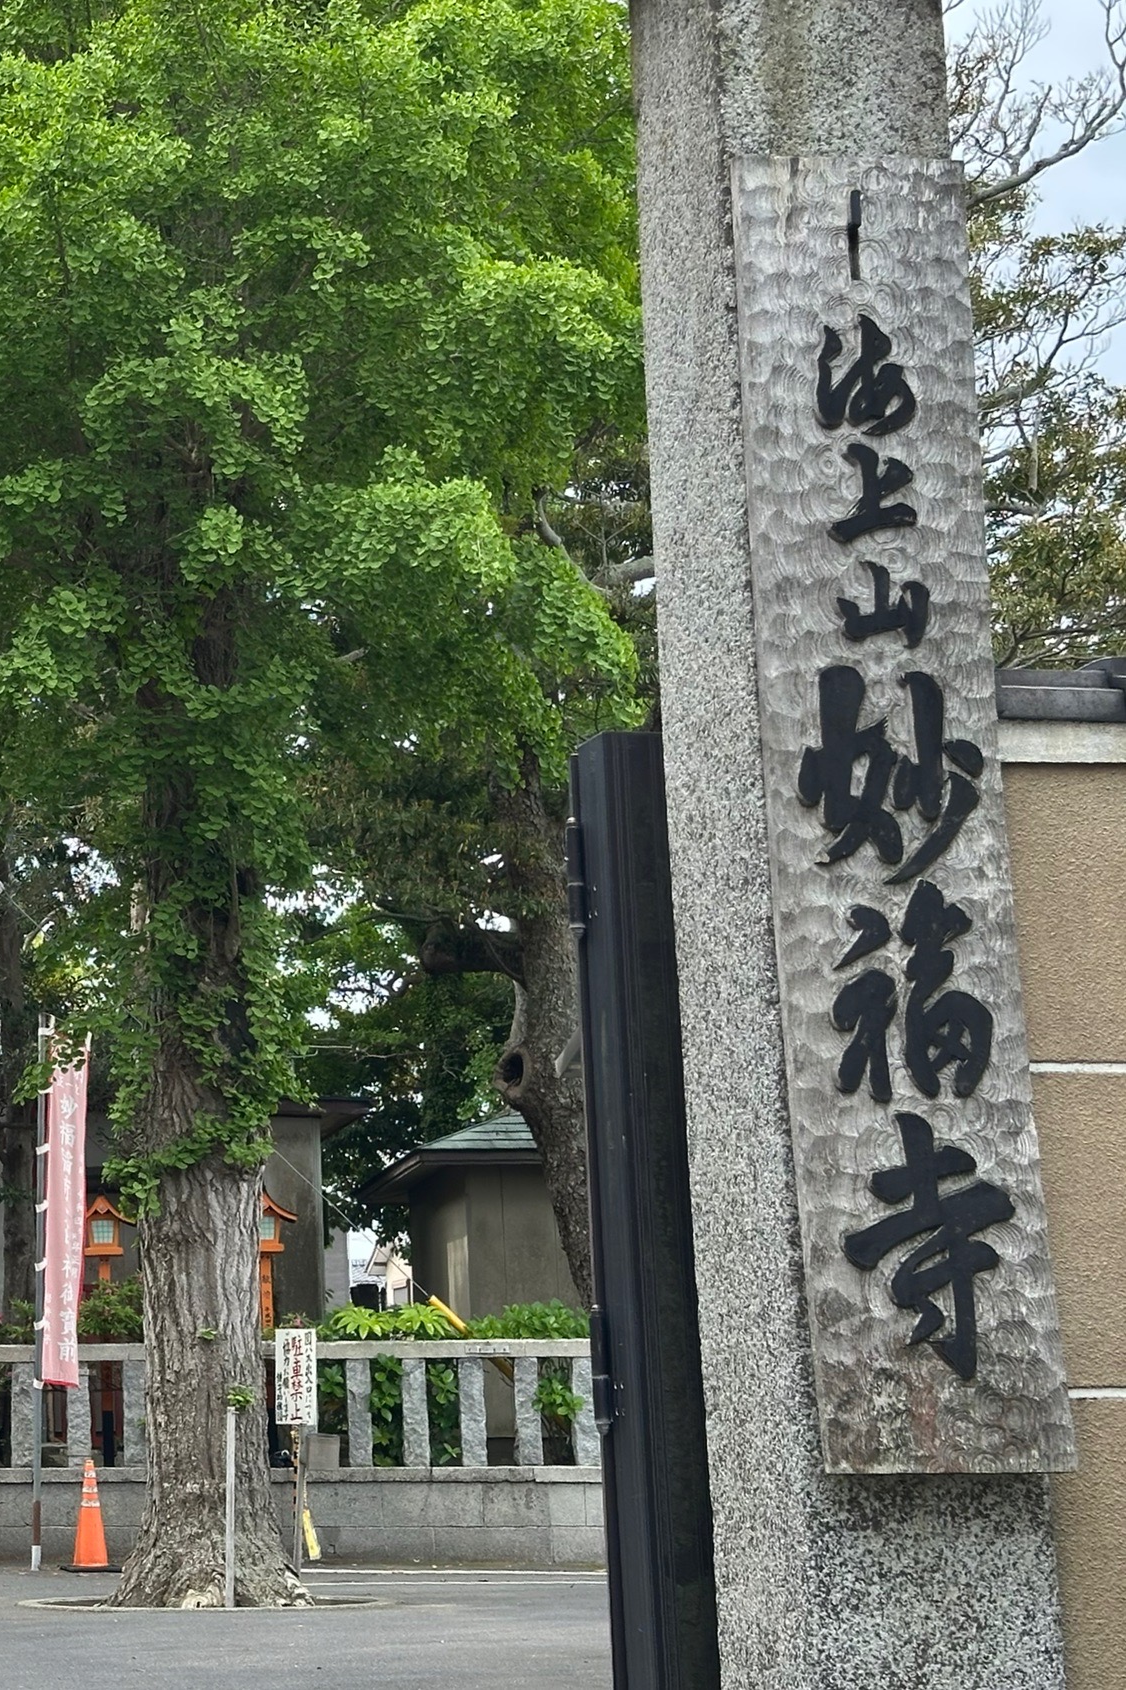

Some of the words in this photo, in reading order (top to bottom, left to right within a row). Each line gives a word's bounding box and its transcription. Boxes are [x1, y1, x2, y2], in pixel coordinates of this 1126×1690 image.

[798, 314, 1015, 1382] 海上山妙福寺
[290, 1335, 304, 1420] 駐車禁止
